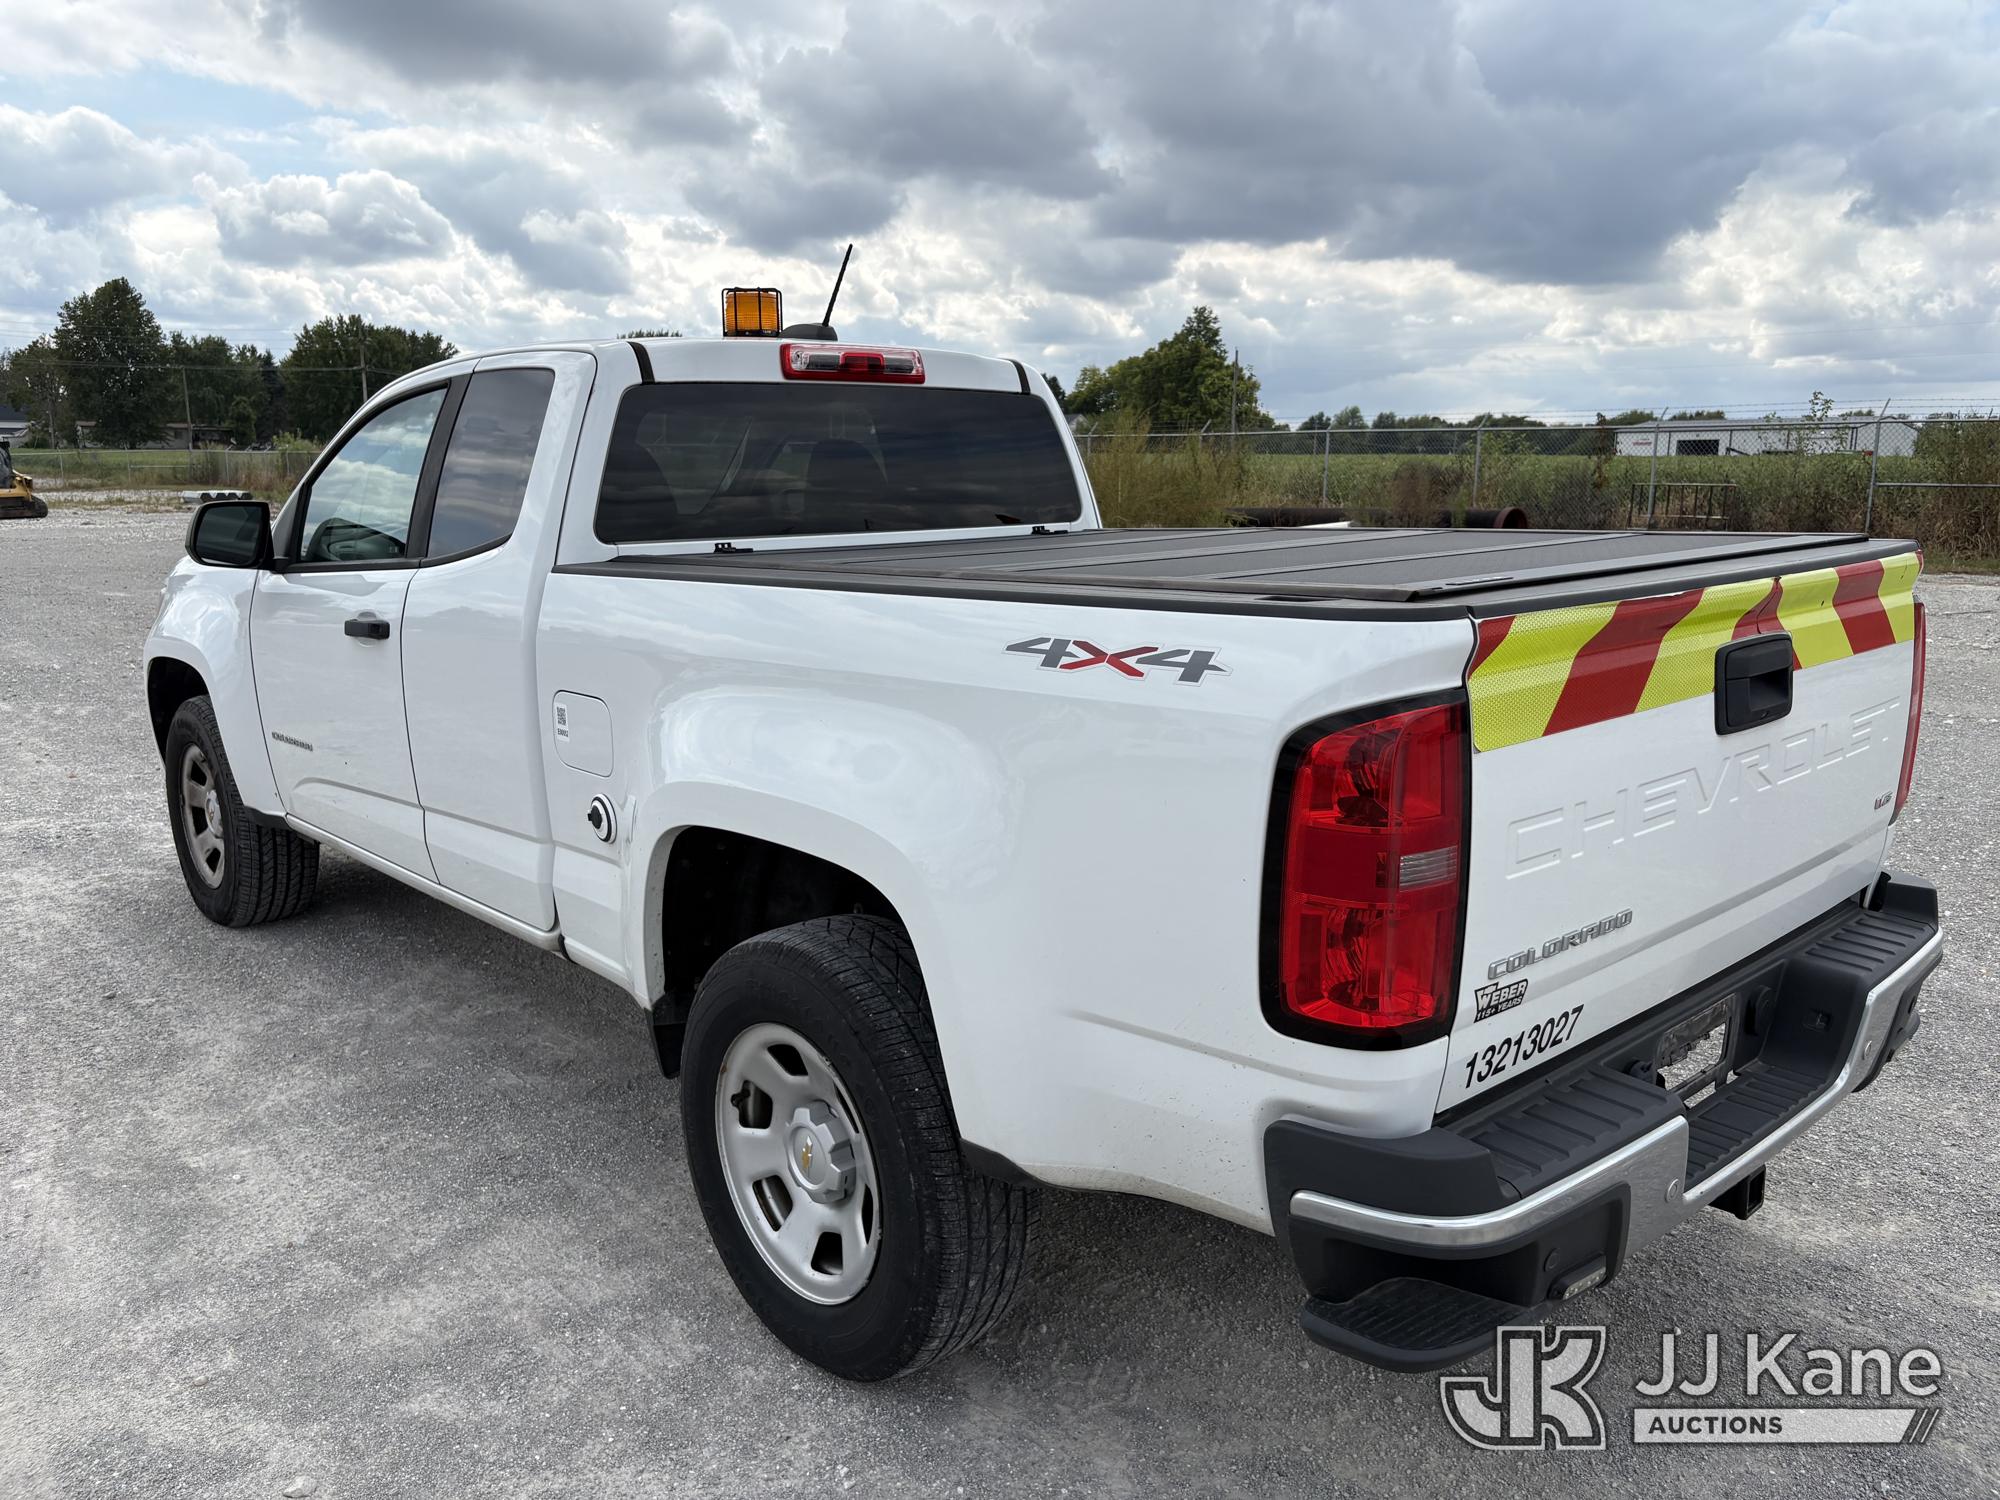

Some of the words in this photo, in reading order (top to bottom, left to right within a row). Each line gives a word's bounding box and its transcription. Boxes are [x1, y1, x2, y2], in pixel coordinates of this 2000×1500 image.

[1003, 636, 1230, 684] 4X4
[1506, 695, 1900, 880] CHEVROLET
[1487, 908, 1633, 980] COLORADO
[1475, 980, 1527, 1011] WEBER
[1497, 995, 1522, 1012] YEARS
[1465, 1003, 1585, 1089] 13213027
